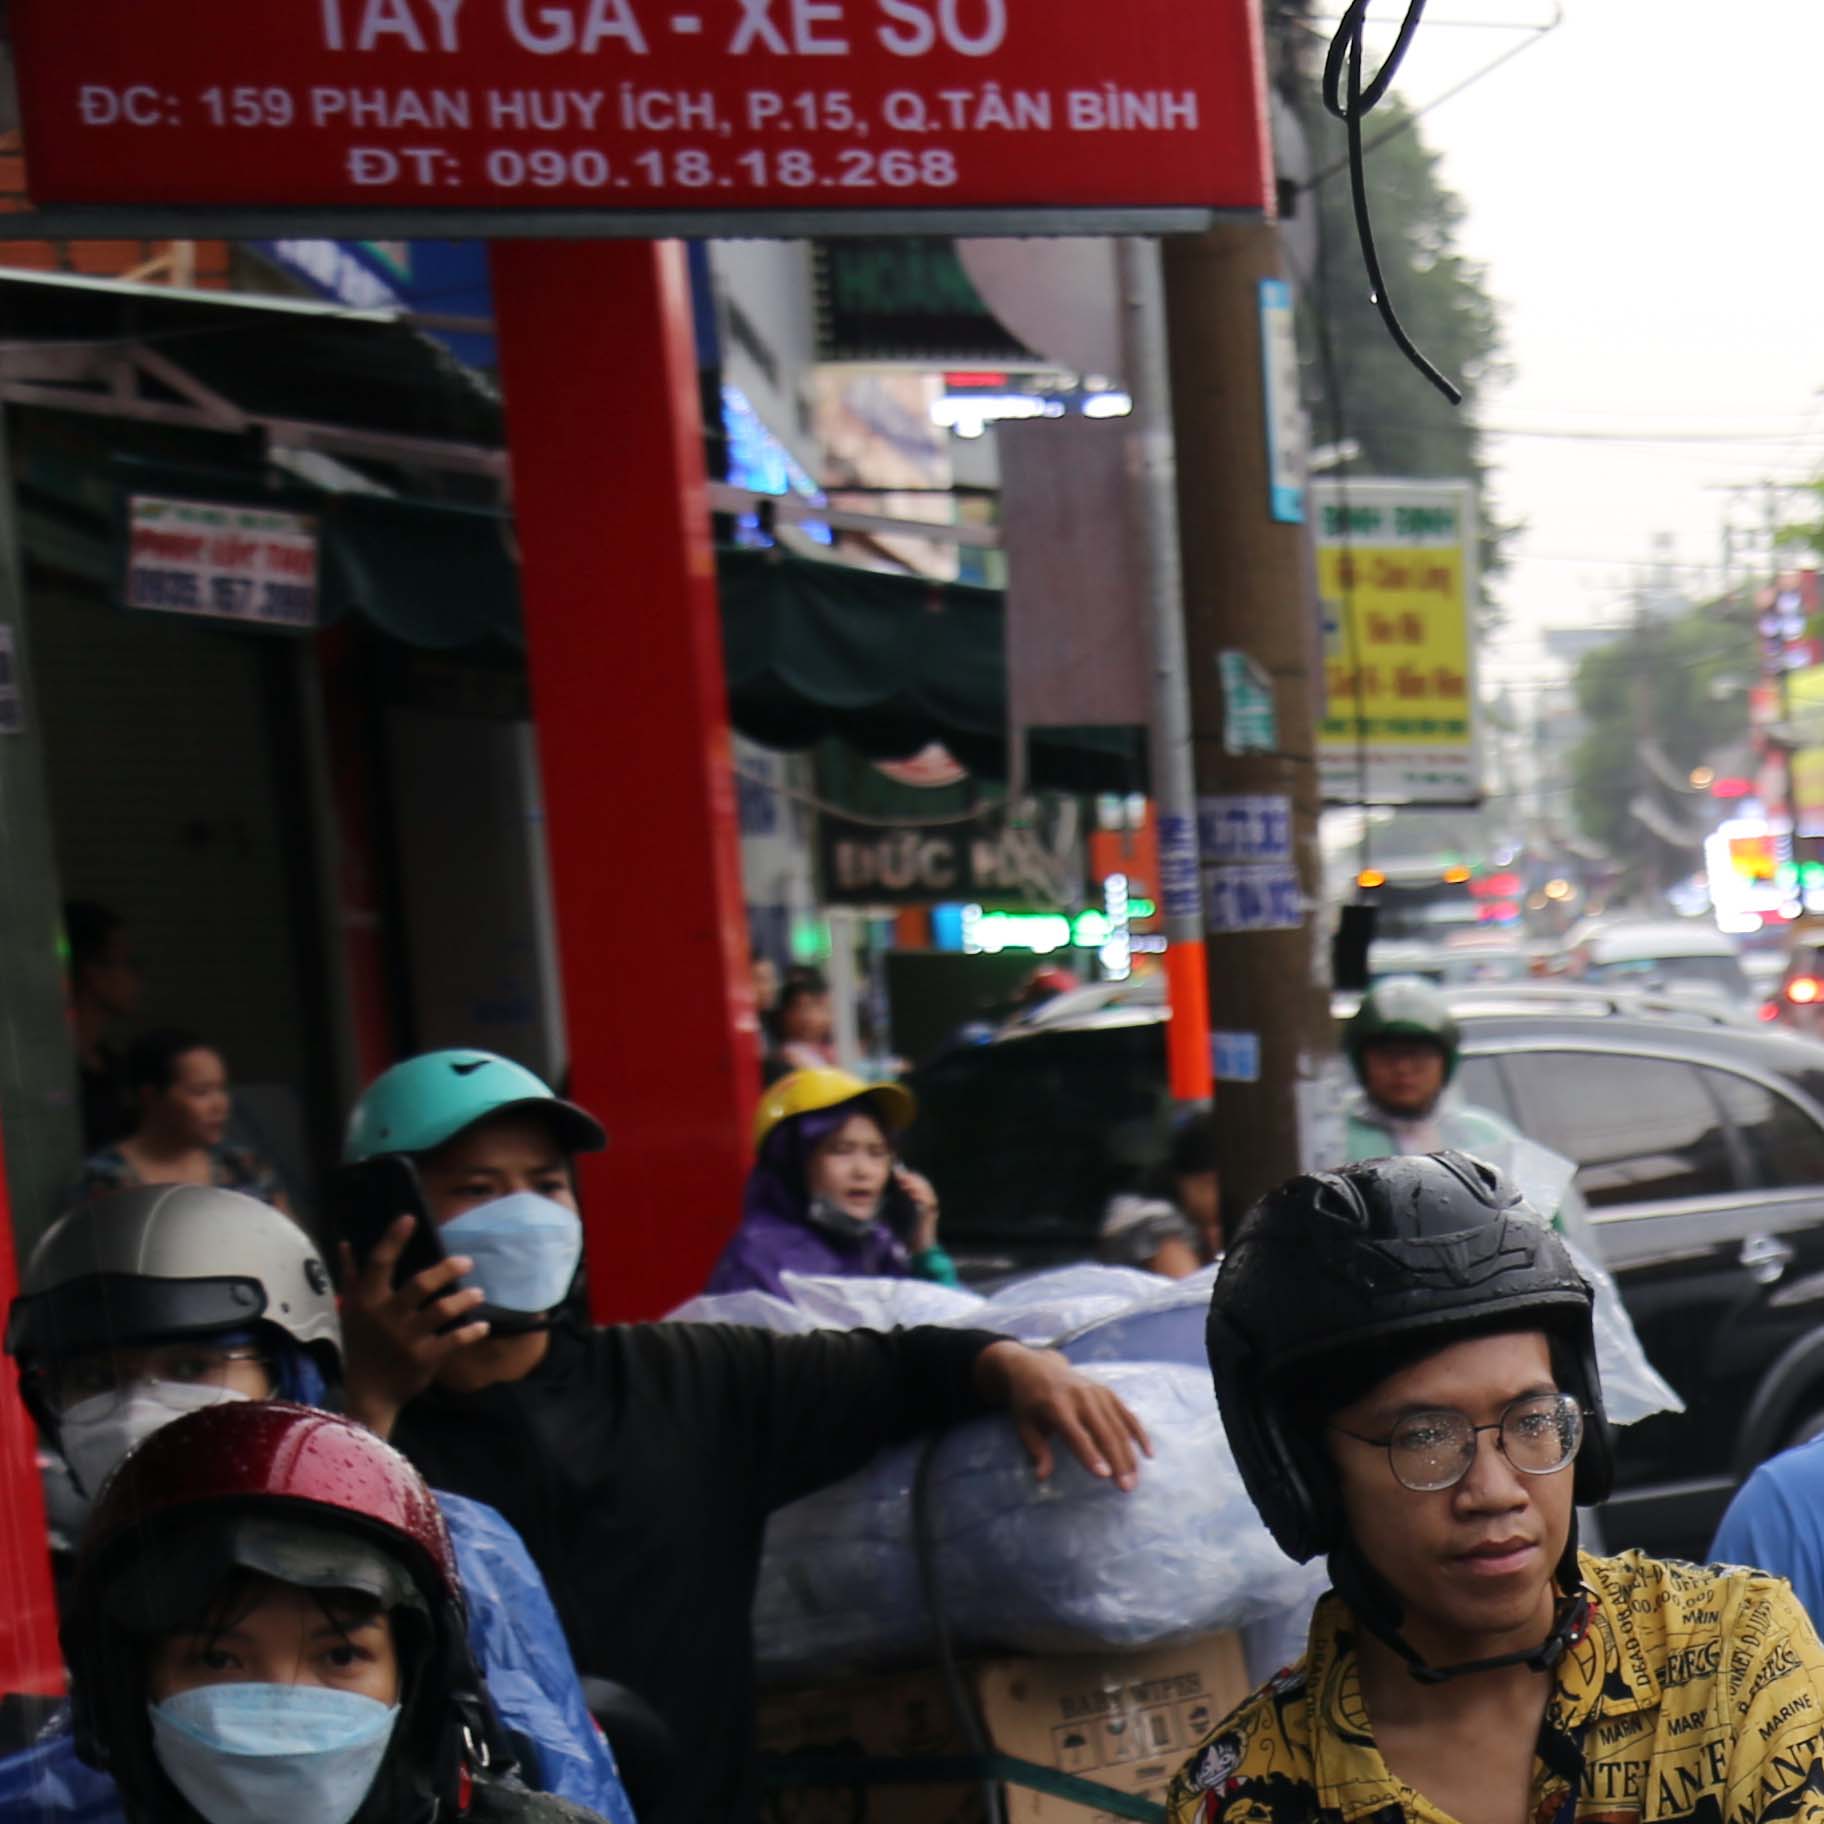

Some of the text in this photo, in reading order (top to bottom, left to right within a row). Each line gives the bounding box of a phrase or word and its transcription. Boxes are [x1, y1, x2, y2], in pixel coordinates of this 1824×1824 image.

[727, 0, 849, 55] XE
[78, 82, 1198, 137] ĐC: 159 PHAN HUY ÍCH, P.15, Q.TÂN BÌNH
[346, 147, 958, 187] ĐT: 090.18.18.268
[1758, 1692, 1814, 1742] MARINE
